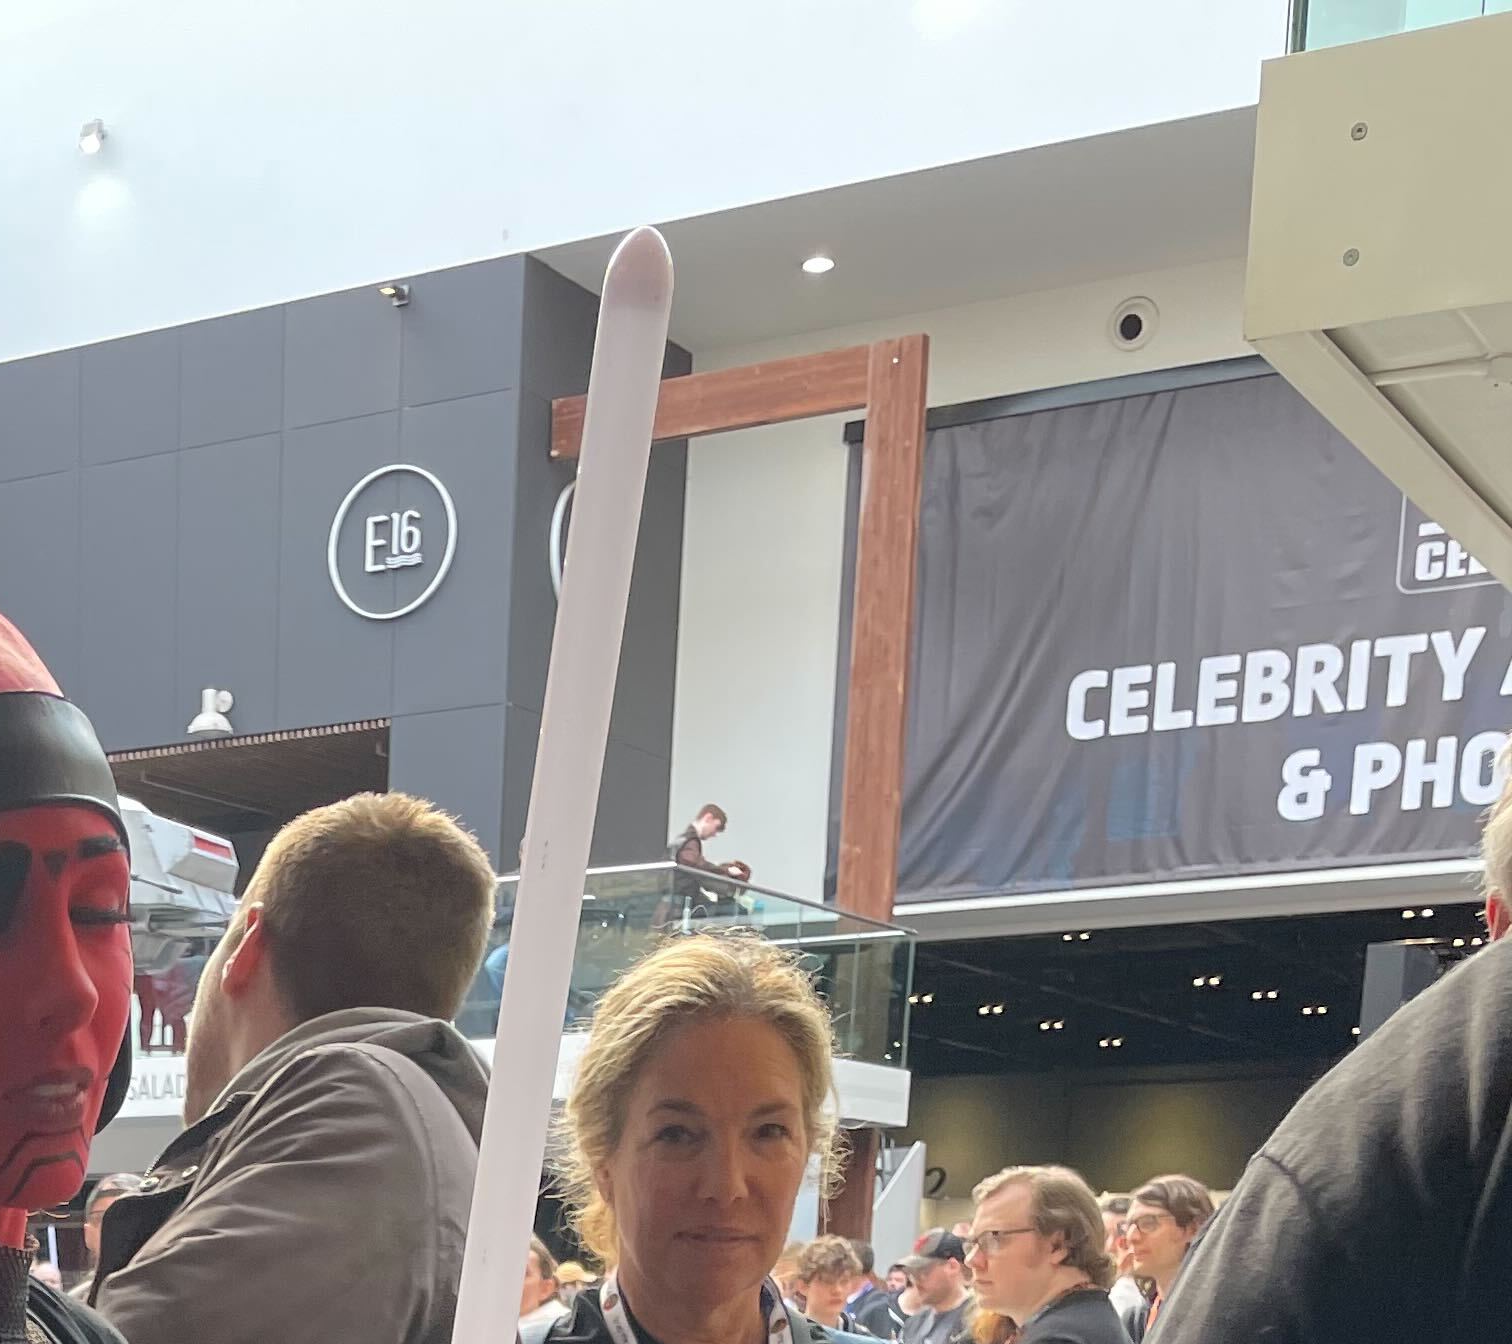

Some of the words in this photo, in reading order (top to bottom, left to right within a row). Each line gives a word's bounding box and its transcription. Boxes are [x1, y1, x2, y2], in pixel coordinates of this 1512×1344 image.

[364, 509, 422, 573] E16
[1065, 626, 1487, 741] CELEBRITY
[1277, 748, 1332, 822] &
